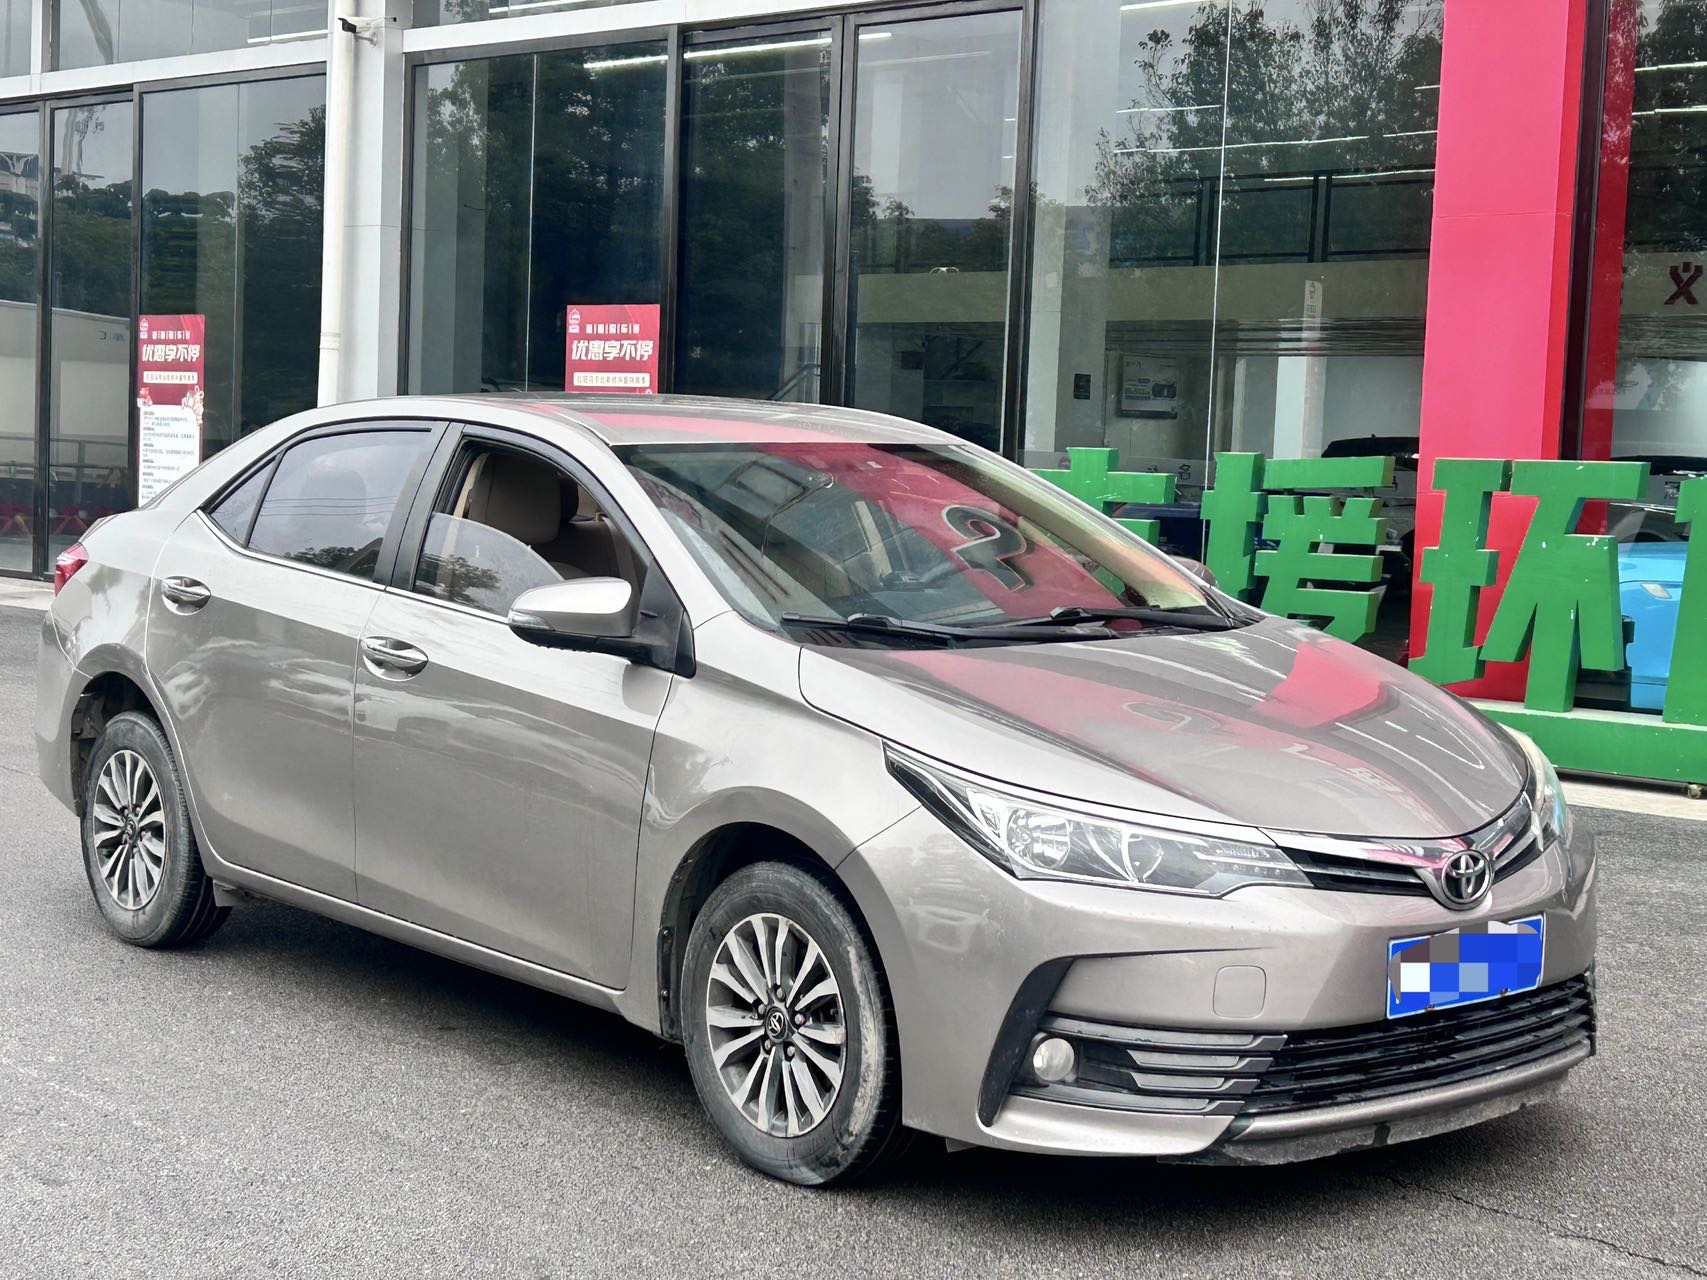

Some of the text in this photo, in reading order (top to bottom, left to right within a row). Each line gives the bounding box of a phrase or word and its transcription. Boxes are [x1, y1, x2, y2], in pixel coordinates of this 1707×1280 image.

[142, 343, 201, 362] 优惠享不停
[571, 339, 654, 361] 优惠享不停
